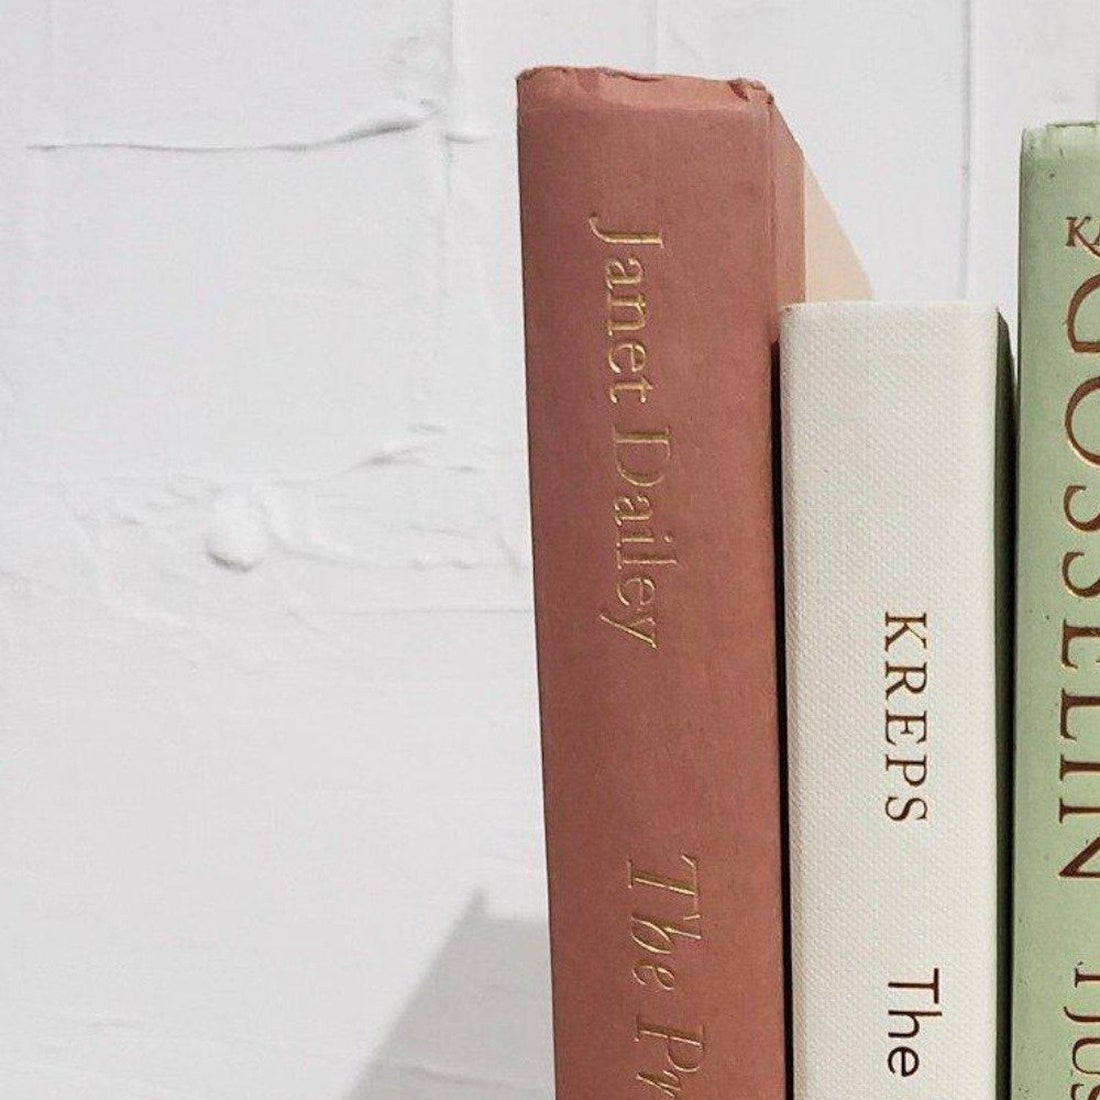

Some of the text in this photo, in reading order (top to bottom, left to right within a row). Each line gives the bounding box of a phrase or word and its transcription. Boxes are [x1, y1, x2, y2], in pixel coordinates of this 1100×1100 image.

[589, 212, 677, 649] Janet Dailey
[885, 612, 928, 822] KREPS
[626, 850, 701, 991] The
[887, 967, 943, 1077] The
